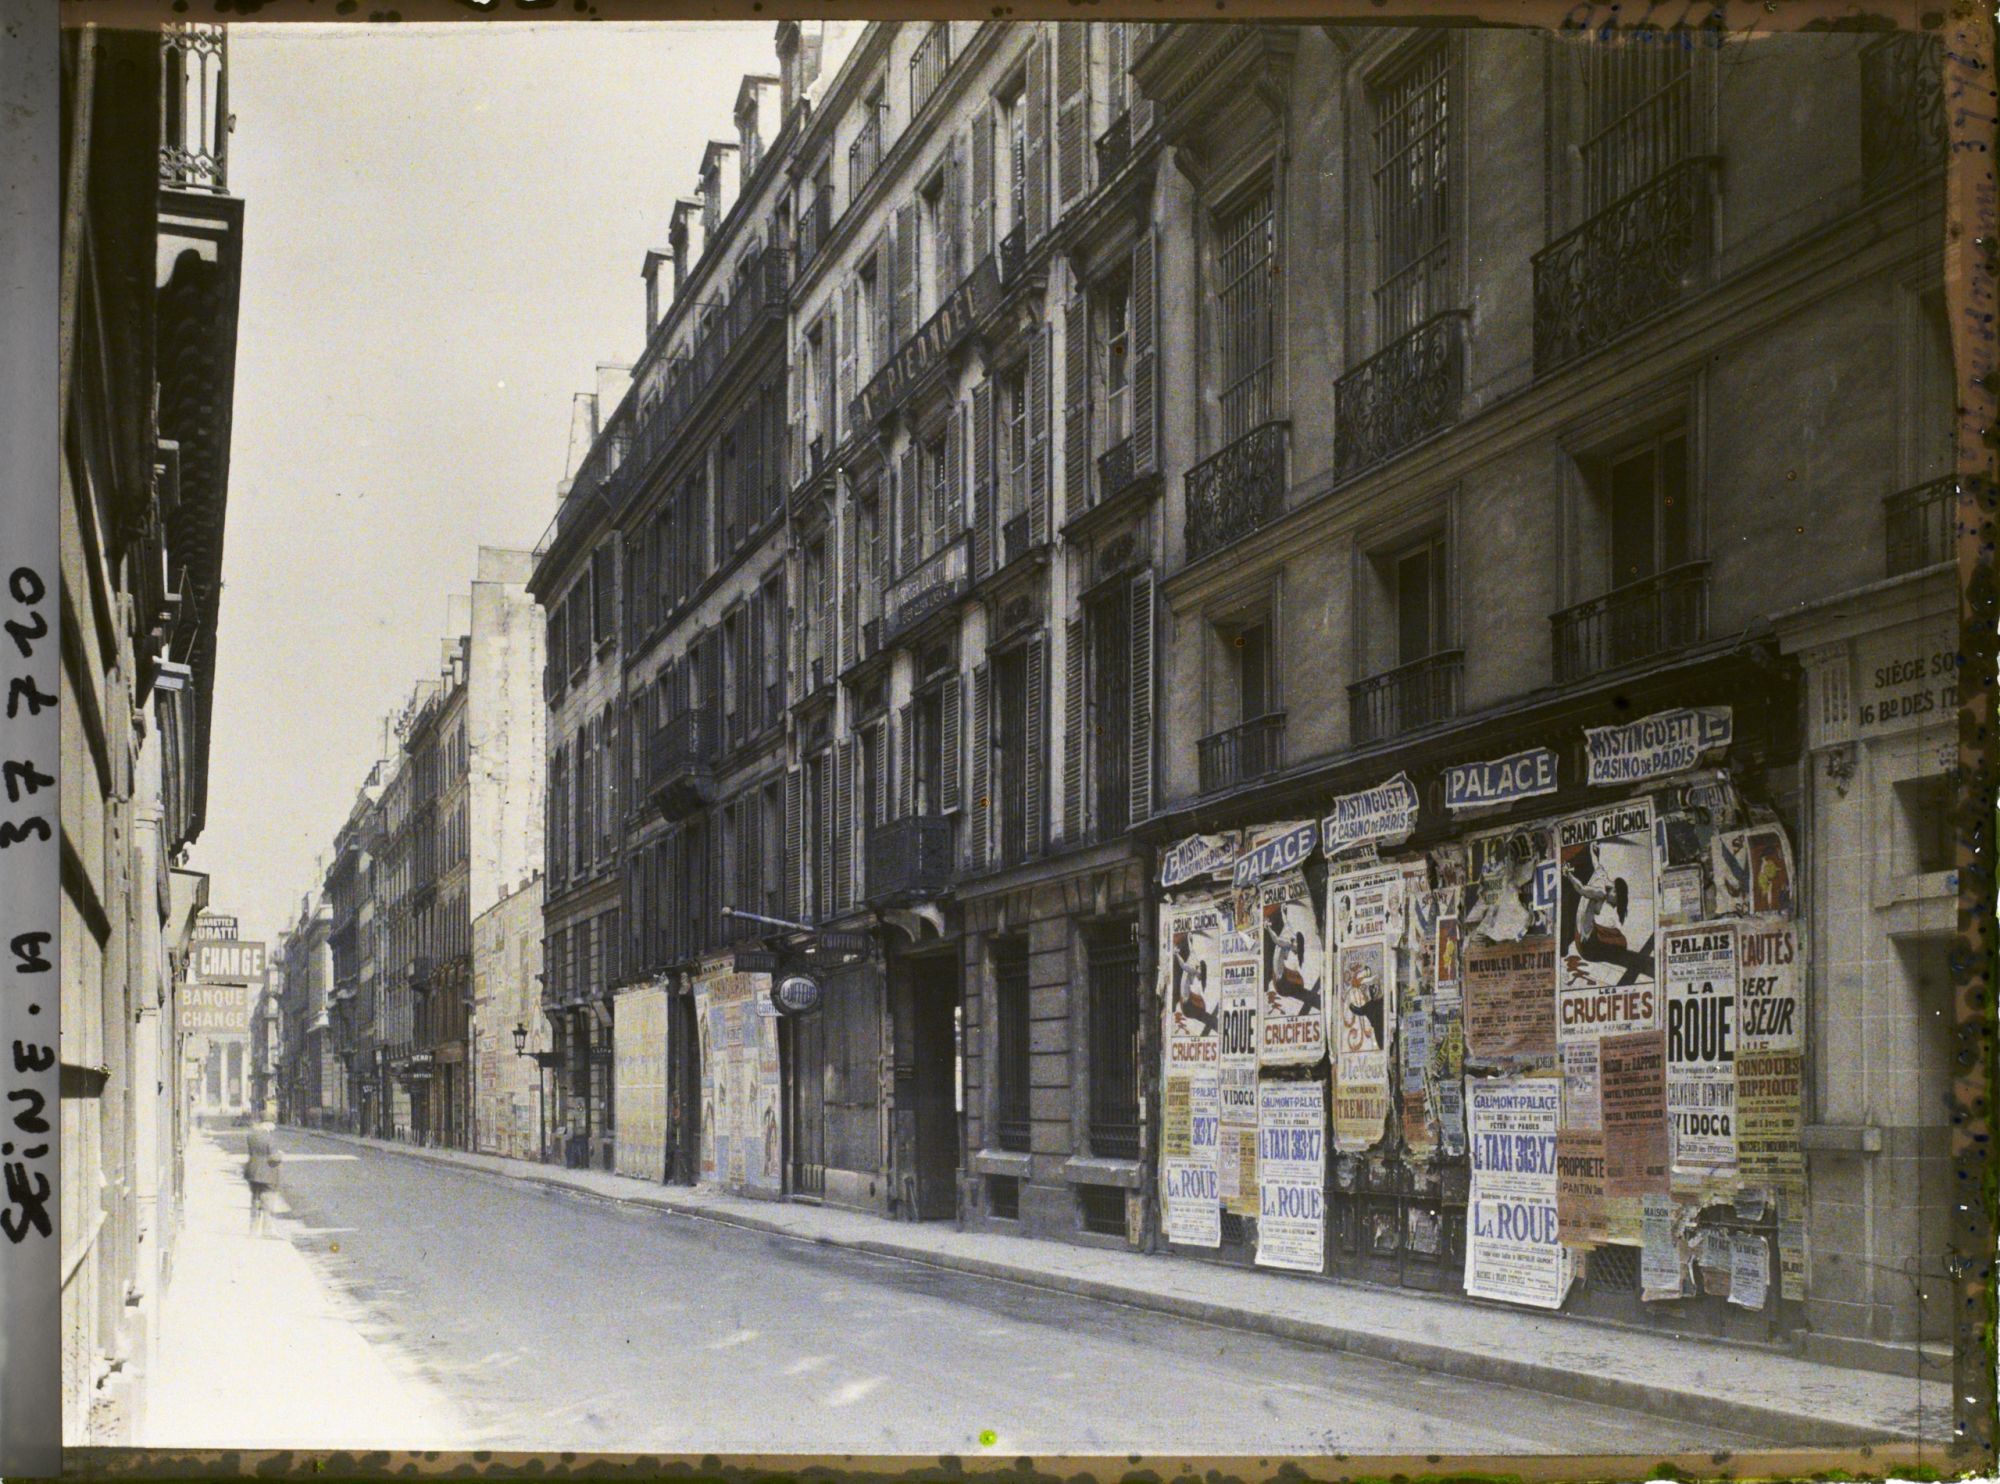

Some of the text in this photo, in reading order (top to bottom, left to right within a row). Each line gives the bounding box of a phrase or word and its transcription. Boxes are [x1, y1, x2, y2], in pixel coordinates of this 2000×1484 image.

[1859, 705, 1875, 726] 16
[1902, 690, 1934, 717] DES
[1590, 712, 1695, 756] MISTINGUETT
[1451, 755, 1552, 798] PALACE
[1592, 746, 1696, 780] CASINO DE PARIS
[0, 760, 55, 849] 37
[1338, 787, 1405, 823] MISTINGUETT
[1338, 816, 1371, 841] CASINO
[1379, 812, 1406, 833] PARIS
[1561, 809, 1649, 846] GRAND GUIGNOL
[1238, 828, 1312, 885] PALACE
[1173, 918, 1192, 933] GRAND
[10, 931, 52, 974] A
[1671, 935, 1730, 954] PALAIS
[201, 946, 262, 977] CHANGE
[1225, 967, 1255, 979] PALAIS
[182, 989, 245, 1007] BANQUE
[1232, 998, 1246, 1007] LA
[1687, 981, 1714, 995] LA
[181, 1011, 245, 1027] CHANGE
[1222, 1009, 1256, 1055] ROUE
[1667, 996, 1735, 1063] ROUE
[1737, 1057, 1800, 1077] CONCOURS
[1223, 1089, 1255, 1106] VIDOCQ
[1739, 1078, 1799, 1098] HIPPIQUE
[1269, 1128, 1289, 1160] TAXI
[1484, 1134, 1513, 1172] TAXI
[1181, 1170, 1218, 1200] ROUE
[1261, 1185, 1322, 1220] LA ROUE
[1473, 1200, 1559, 1246] LA ROUE
